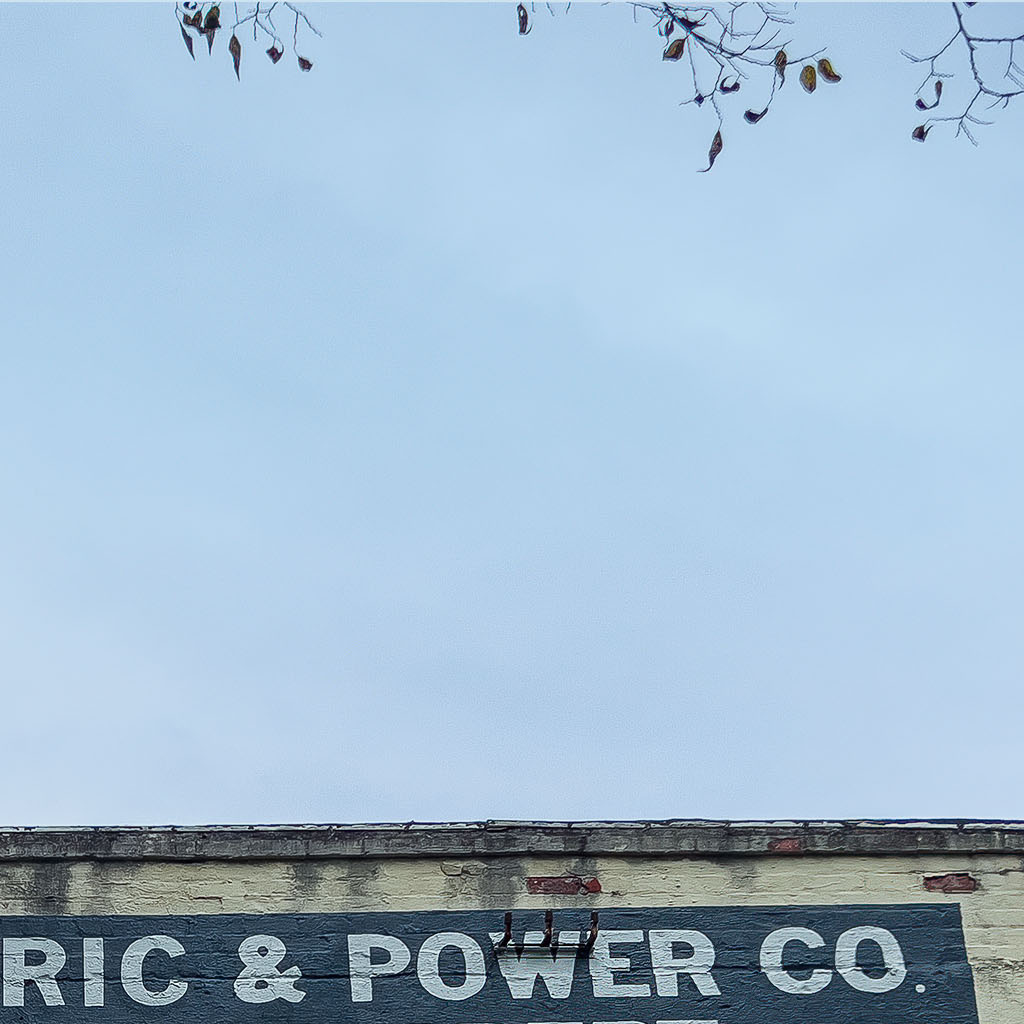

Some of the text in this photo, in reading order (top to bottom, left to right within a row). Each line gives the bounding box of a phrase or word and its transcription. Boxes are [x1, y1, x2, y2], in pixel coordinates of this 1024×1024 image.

[234, 935, 306, 1003] &
[348, 929, 721, 1002] POWER
[760, 926, 925, 994] CO.
